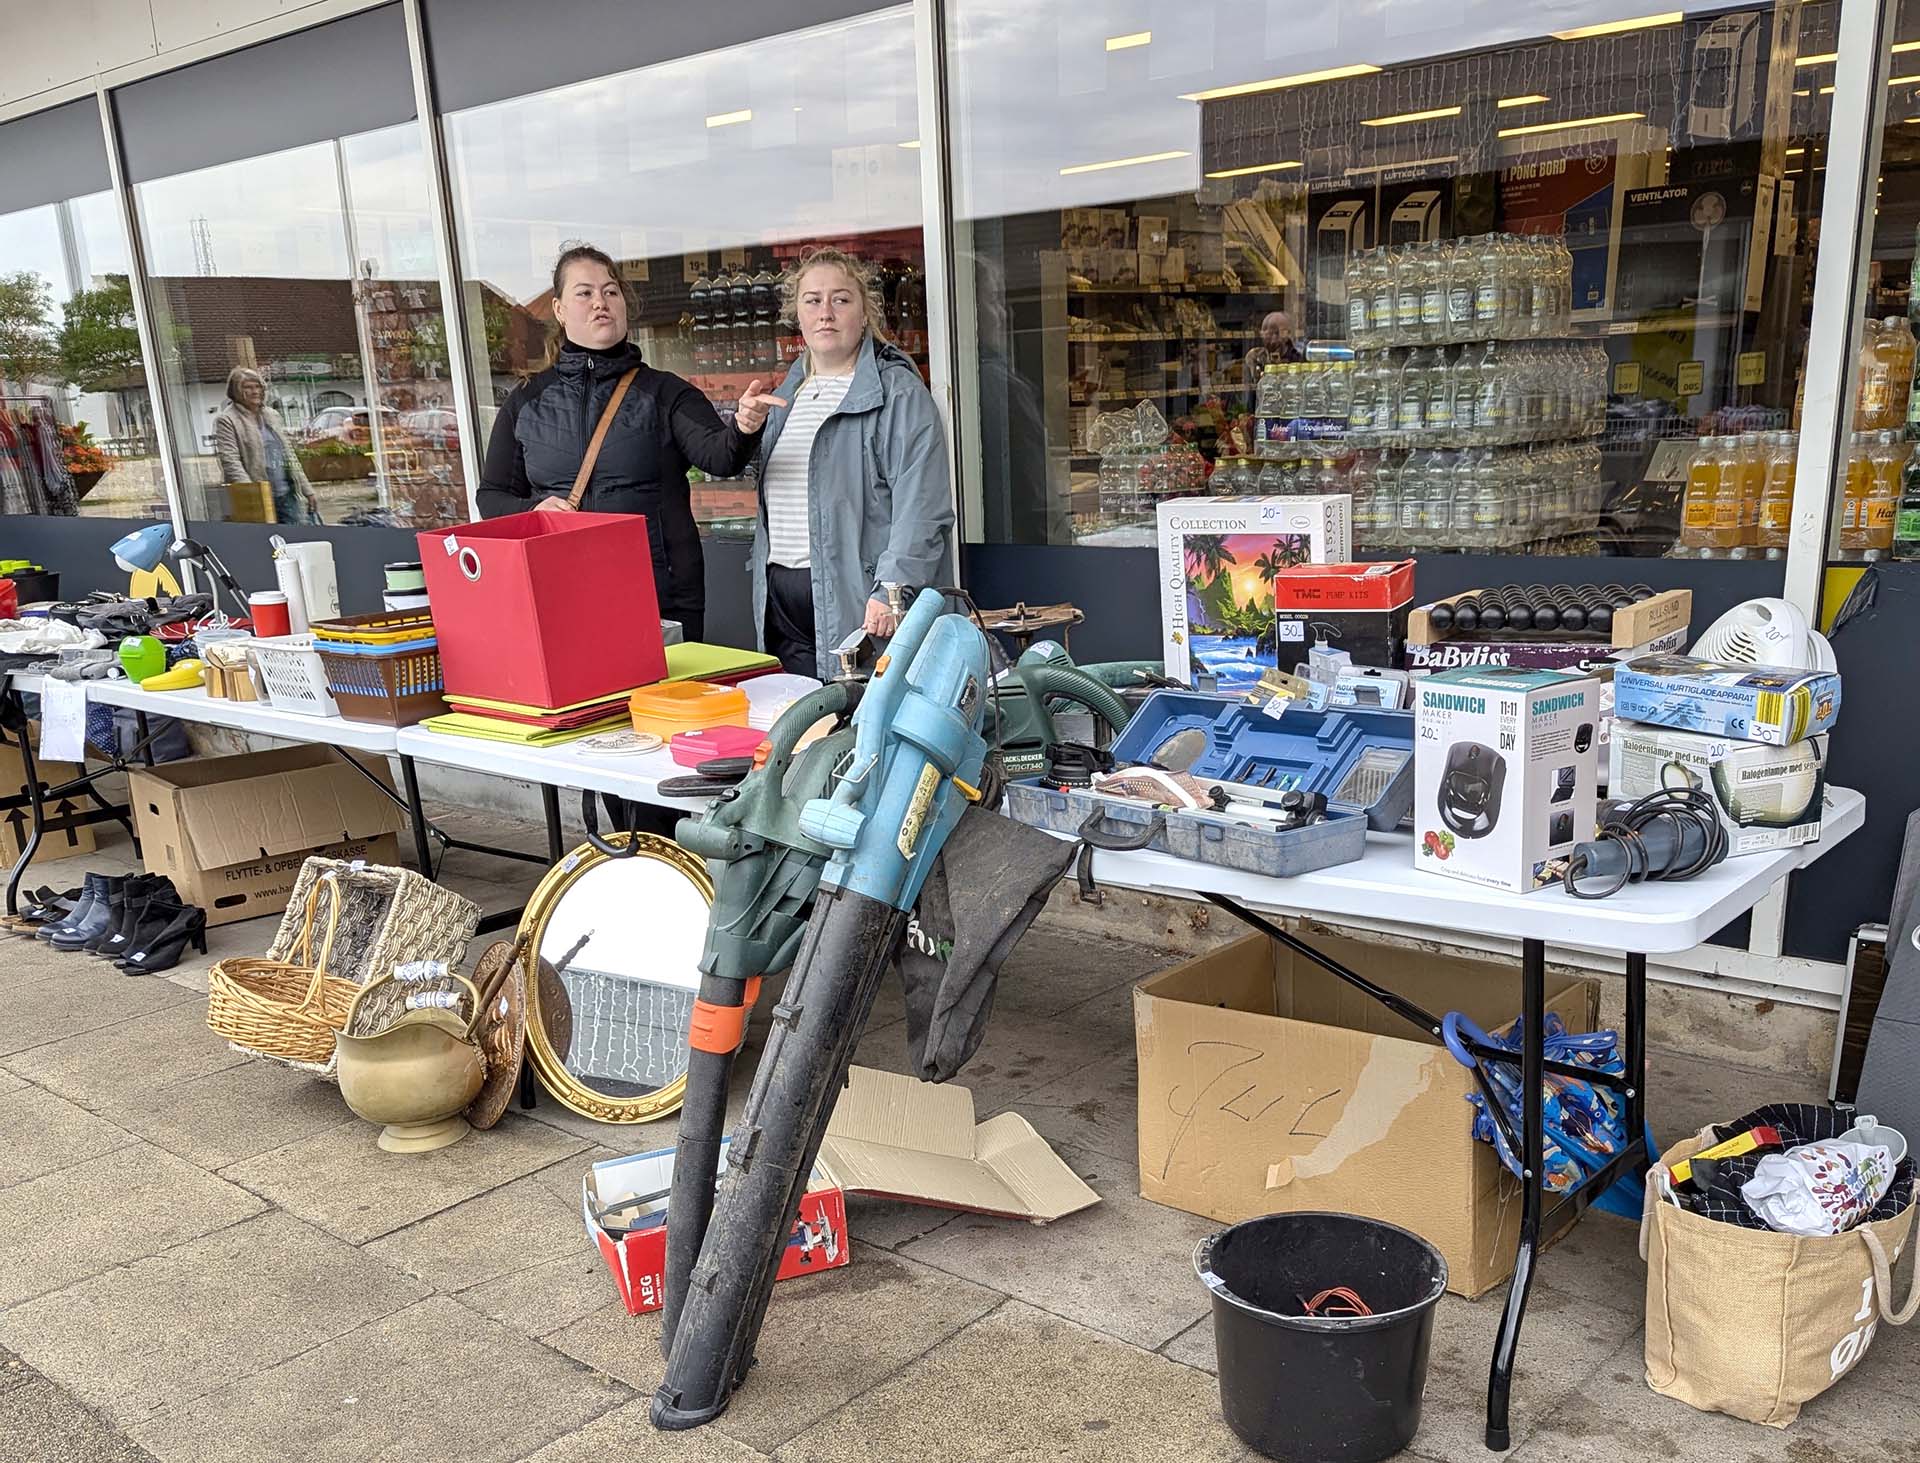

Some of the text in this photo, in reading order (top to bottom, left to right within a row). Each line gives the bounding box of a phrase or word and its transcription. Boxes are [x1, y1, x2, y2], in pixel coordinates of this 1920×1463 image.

[1510, 164, 1537, 181] PONG
[1539, 158, 1567, 177] BORD
[1630, 187, 1688, 203] VENTILATOR
[1875, 507, 1896, 519] Har
[1169, 516, 1247, 530] COLLECTION
[1325, 505, 1333, 555] 1500
[1169, 533, 1185, 630] HIGH QUALITY
[1293, 588, 1369, 600] TMC PUMP KITS
[1412, 646, 1511, 668] BaByliss
[1621, 676, 1756, 703] UNIVERSAL HURTIGLADEAPPARAT
[1423, 691, 1486, 715] SANDWICH
[1500, 700, 1518, 717] 11:11
[1531, 692, 1585, 716] SANDWICH
[1422, 708, 1453, 720] MAKER
[1500, 715, 1517, 725] EVERY
[1531, 713, 1559, 725] MAKER
[1500, 732, 1517, 751] DAY
[1623, 739, 1717, 767] Halogenlampe med sens
[1741, 766, 1788, 780] Halogenlampe
[1788, 762, 1803, 774] med
[225, 867, 264, 881] FLYTTE-
[265, 863, 272, 874] &
[640, 1274, 656, 1306] AEG
